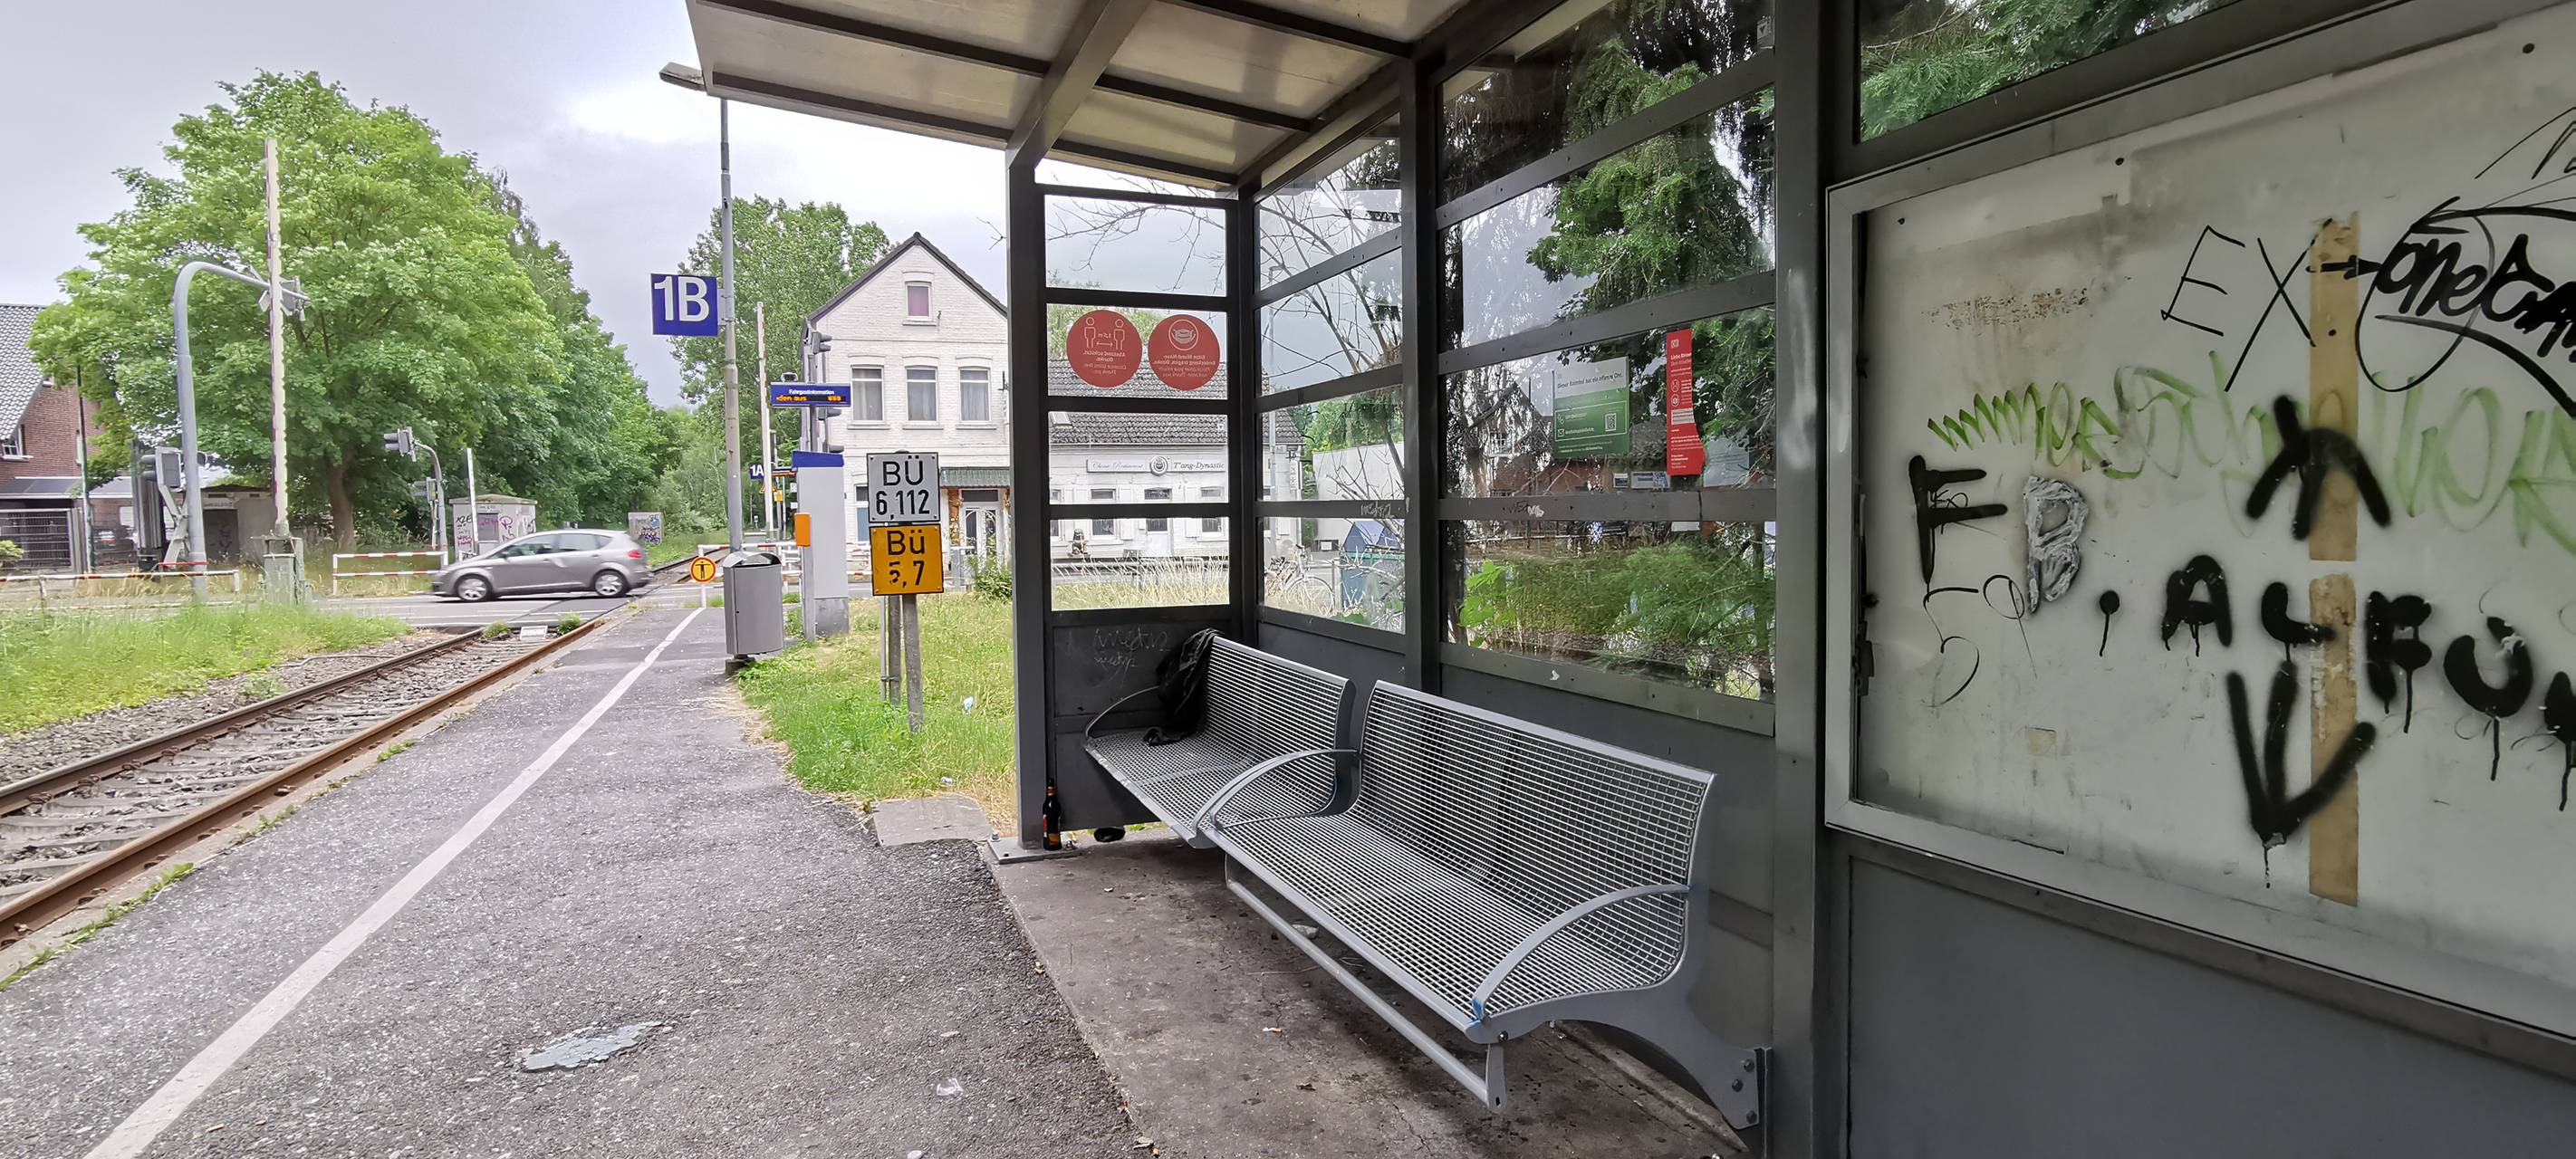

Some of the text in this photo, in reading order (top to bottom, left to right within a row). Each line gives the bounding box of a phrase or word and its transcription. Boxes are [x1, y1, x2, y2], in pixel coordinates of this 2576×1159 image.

[653, 275, 709, 321] 1B
[2161, 218, 2334, 392] EX
[750, 465, 764, 477] 1A
[882, 455, 924, 486] BÜ
[876, 489, 930, 521] 6,112
[887, 529, 926, 556] Bü
